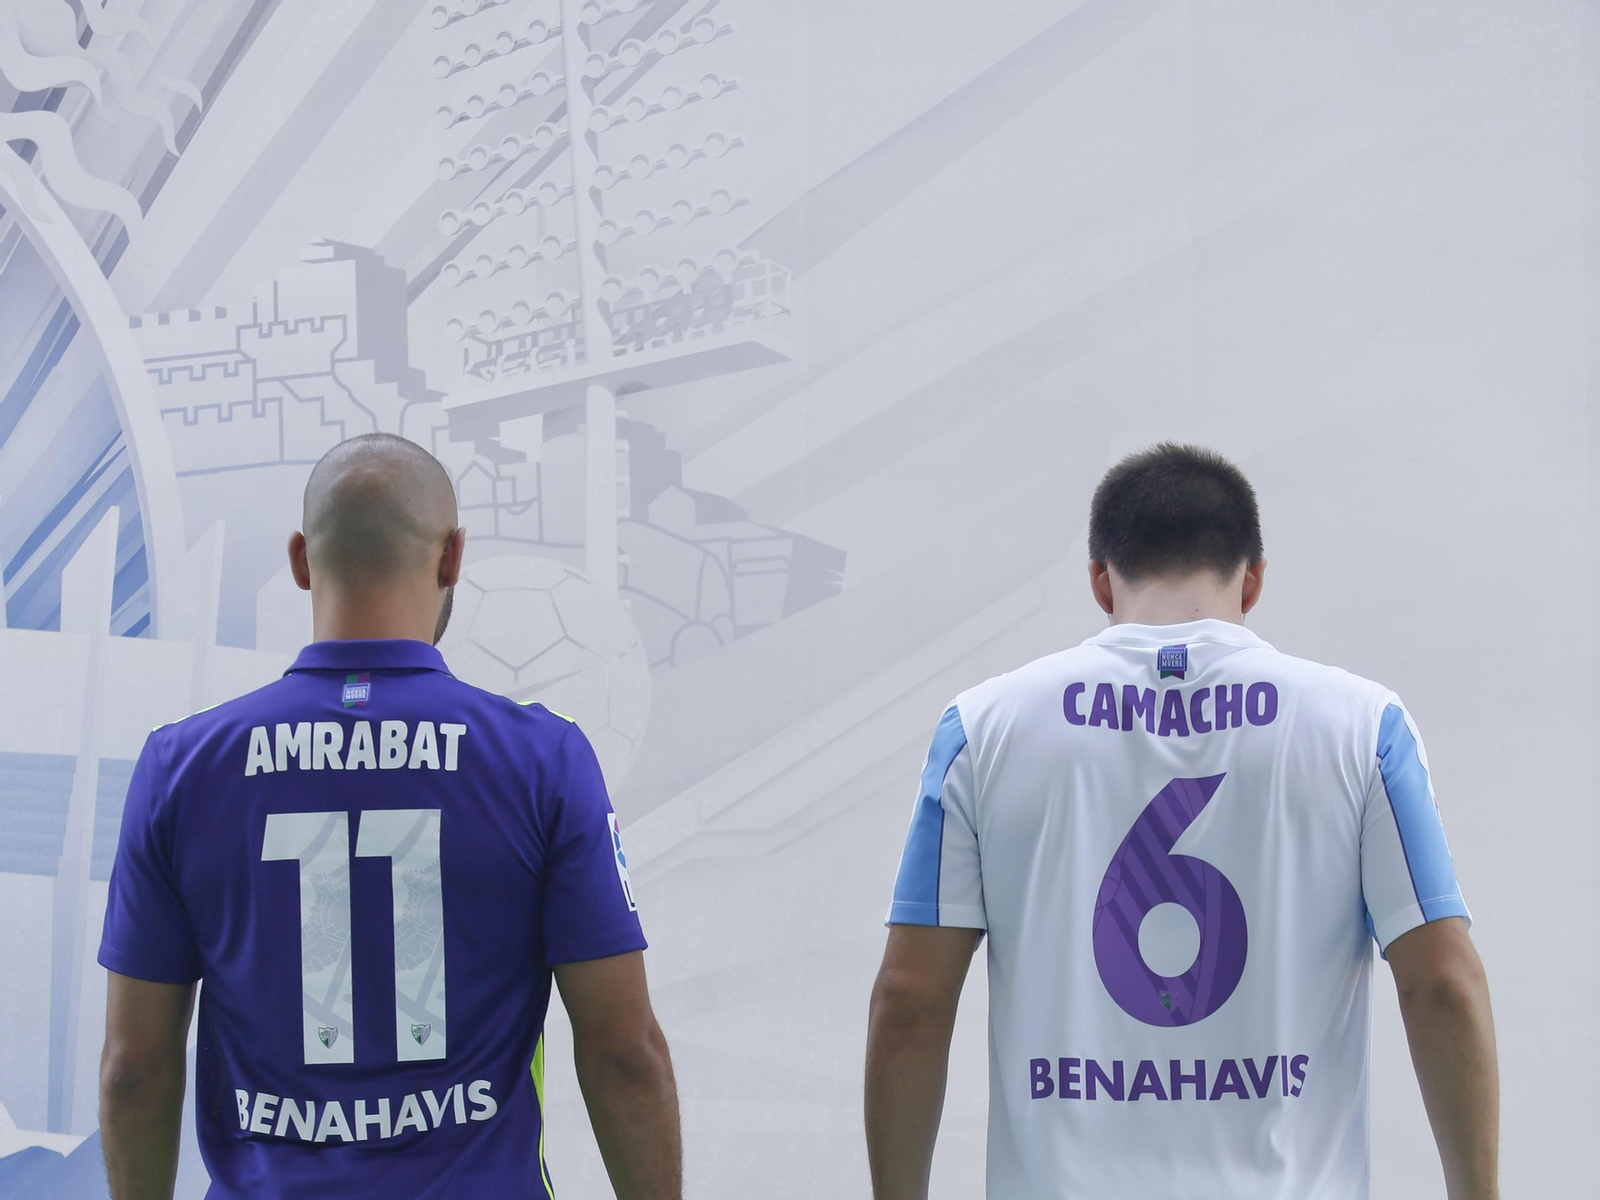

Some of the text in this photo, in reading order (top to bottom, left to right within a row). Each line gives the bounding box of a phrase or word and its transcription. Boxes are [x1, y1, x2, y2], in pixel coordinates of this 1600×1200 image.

[1063, 681, 1279, 737] CAMACHO
[244, 720, 467, 776] AMRABAT
[1092, 771, 1248, 1028] 6
[261, 809, 448, 1065] 11
[1030, 1054, 1310, 1101] BENAHAVIS
[235, 1079, 498, 1142] BENAHAVIS
